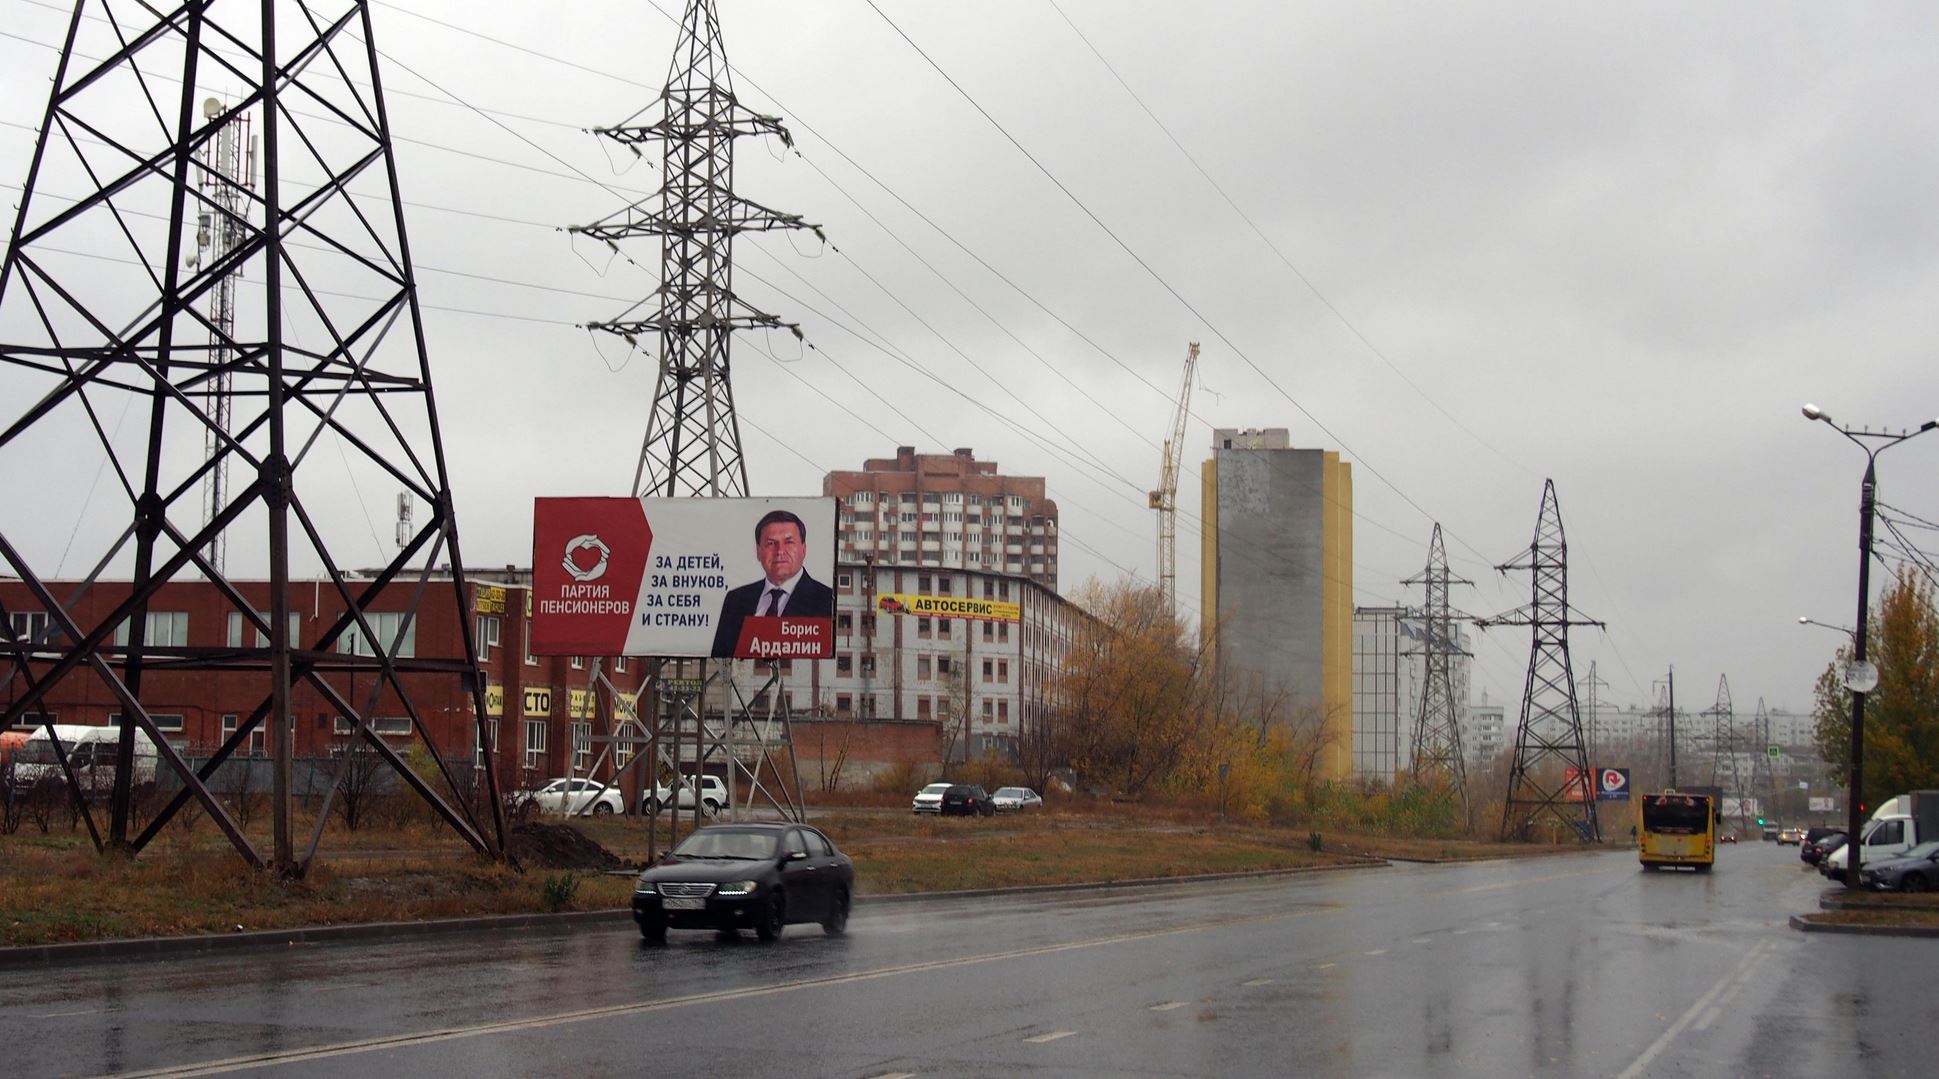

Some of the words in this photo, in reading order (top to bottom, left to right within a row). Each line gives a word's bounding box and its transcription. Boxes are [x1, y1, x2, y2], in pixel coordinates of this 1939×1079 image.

[656, 556, 672, 569] ЗА
[676, 553, 724, 571] ДЕТЕЙ,
[651, 576, 667, 588] ЗА
[672, 576, 729, 590] ВНУКОВ,
[561, 585, 609, 598] ПАРТИЯ
[540, 601, 630, 614] ПЕНСИОНЕРОВ
[646, 595, 663, 607] ЗА
[668, 595, 700, 607] СЕБЯ
[916, 599, 992, 615] АВТОСЕРВИС
[642, 614, 650, 626] И
[656, 614, 709, 627] СТРАНУ!
[781, 621, 819, 638] Борис
[750, 637, 821, 657] Ардалин
[524, 692, 550, 712] СТО
